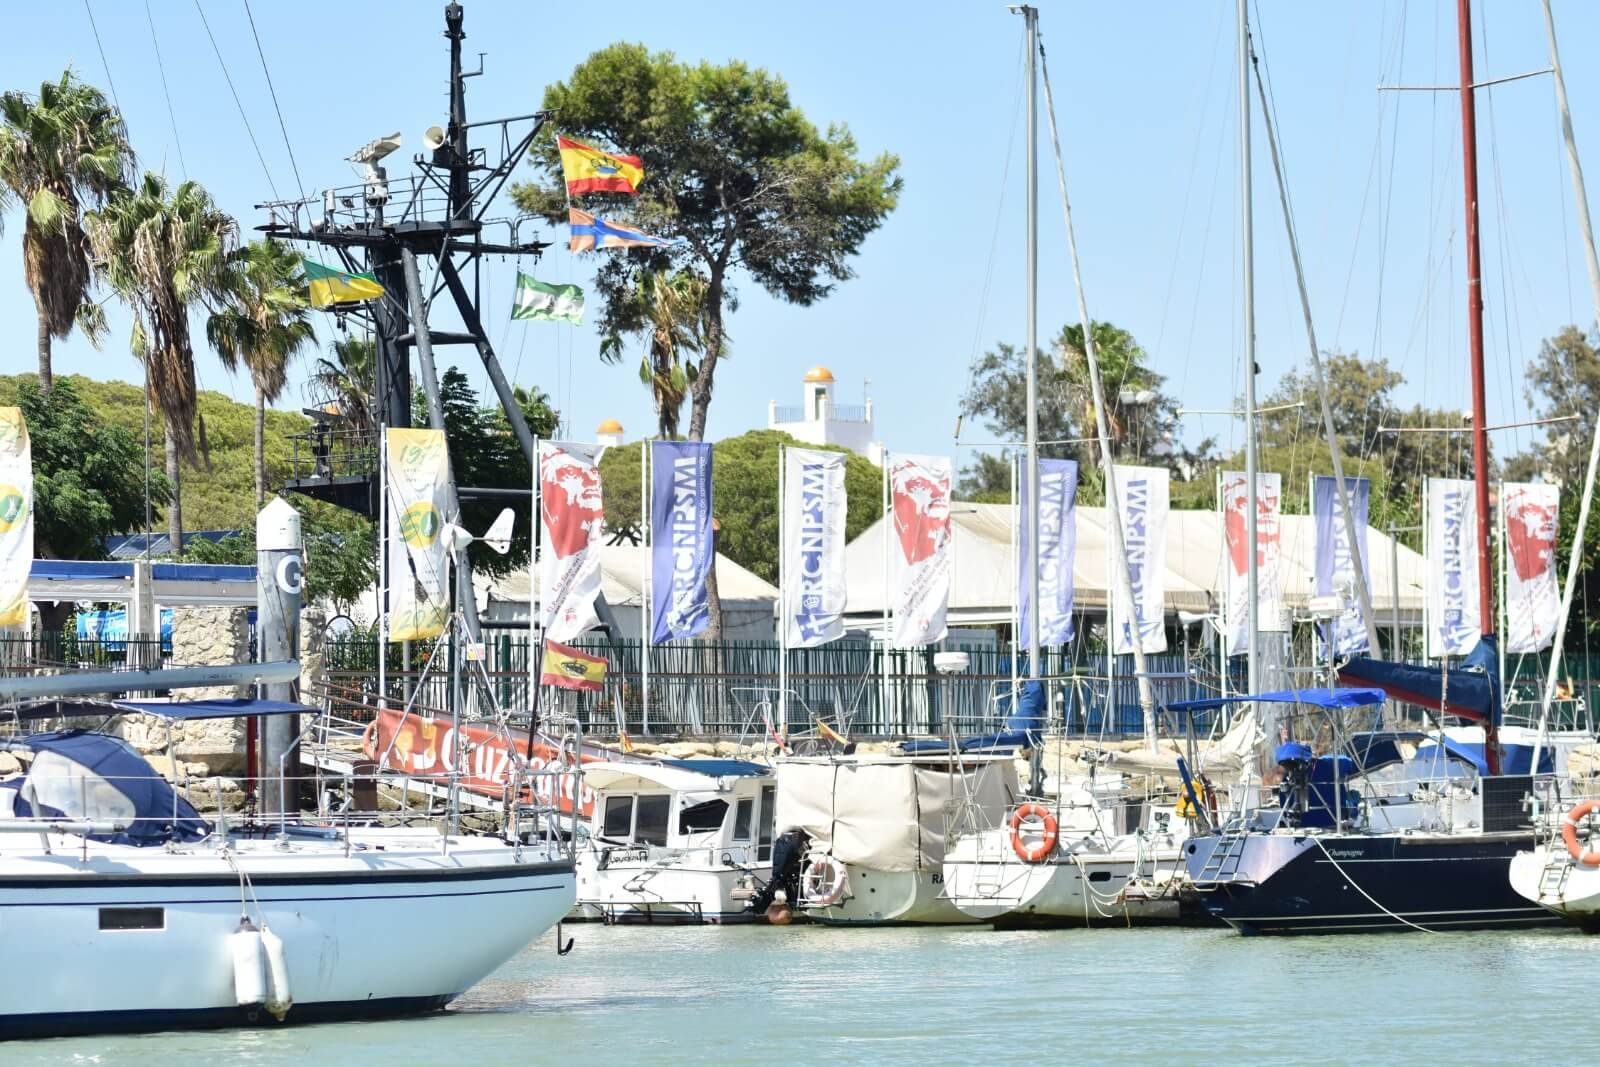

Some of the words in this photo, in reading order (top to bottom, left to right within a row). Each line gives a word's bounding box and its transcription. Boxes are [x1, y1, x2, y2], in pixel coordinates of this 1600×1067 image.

[801, 467, 823, 596] RCNPSM
[1039, 476, 1062, 598] RCNPSM
[277, 554, 302, 595] G
[1327, 848, 1366, 859] Champagne
